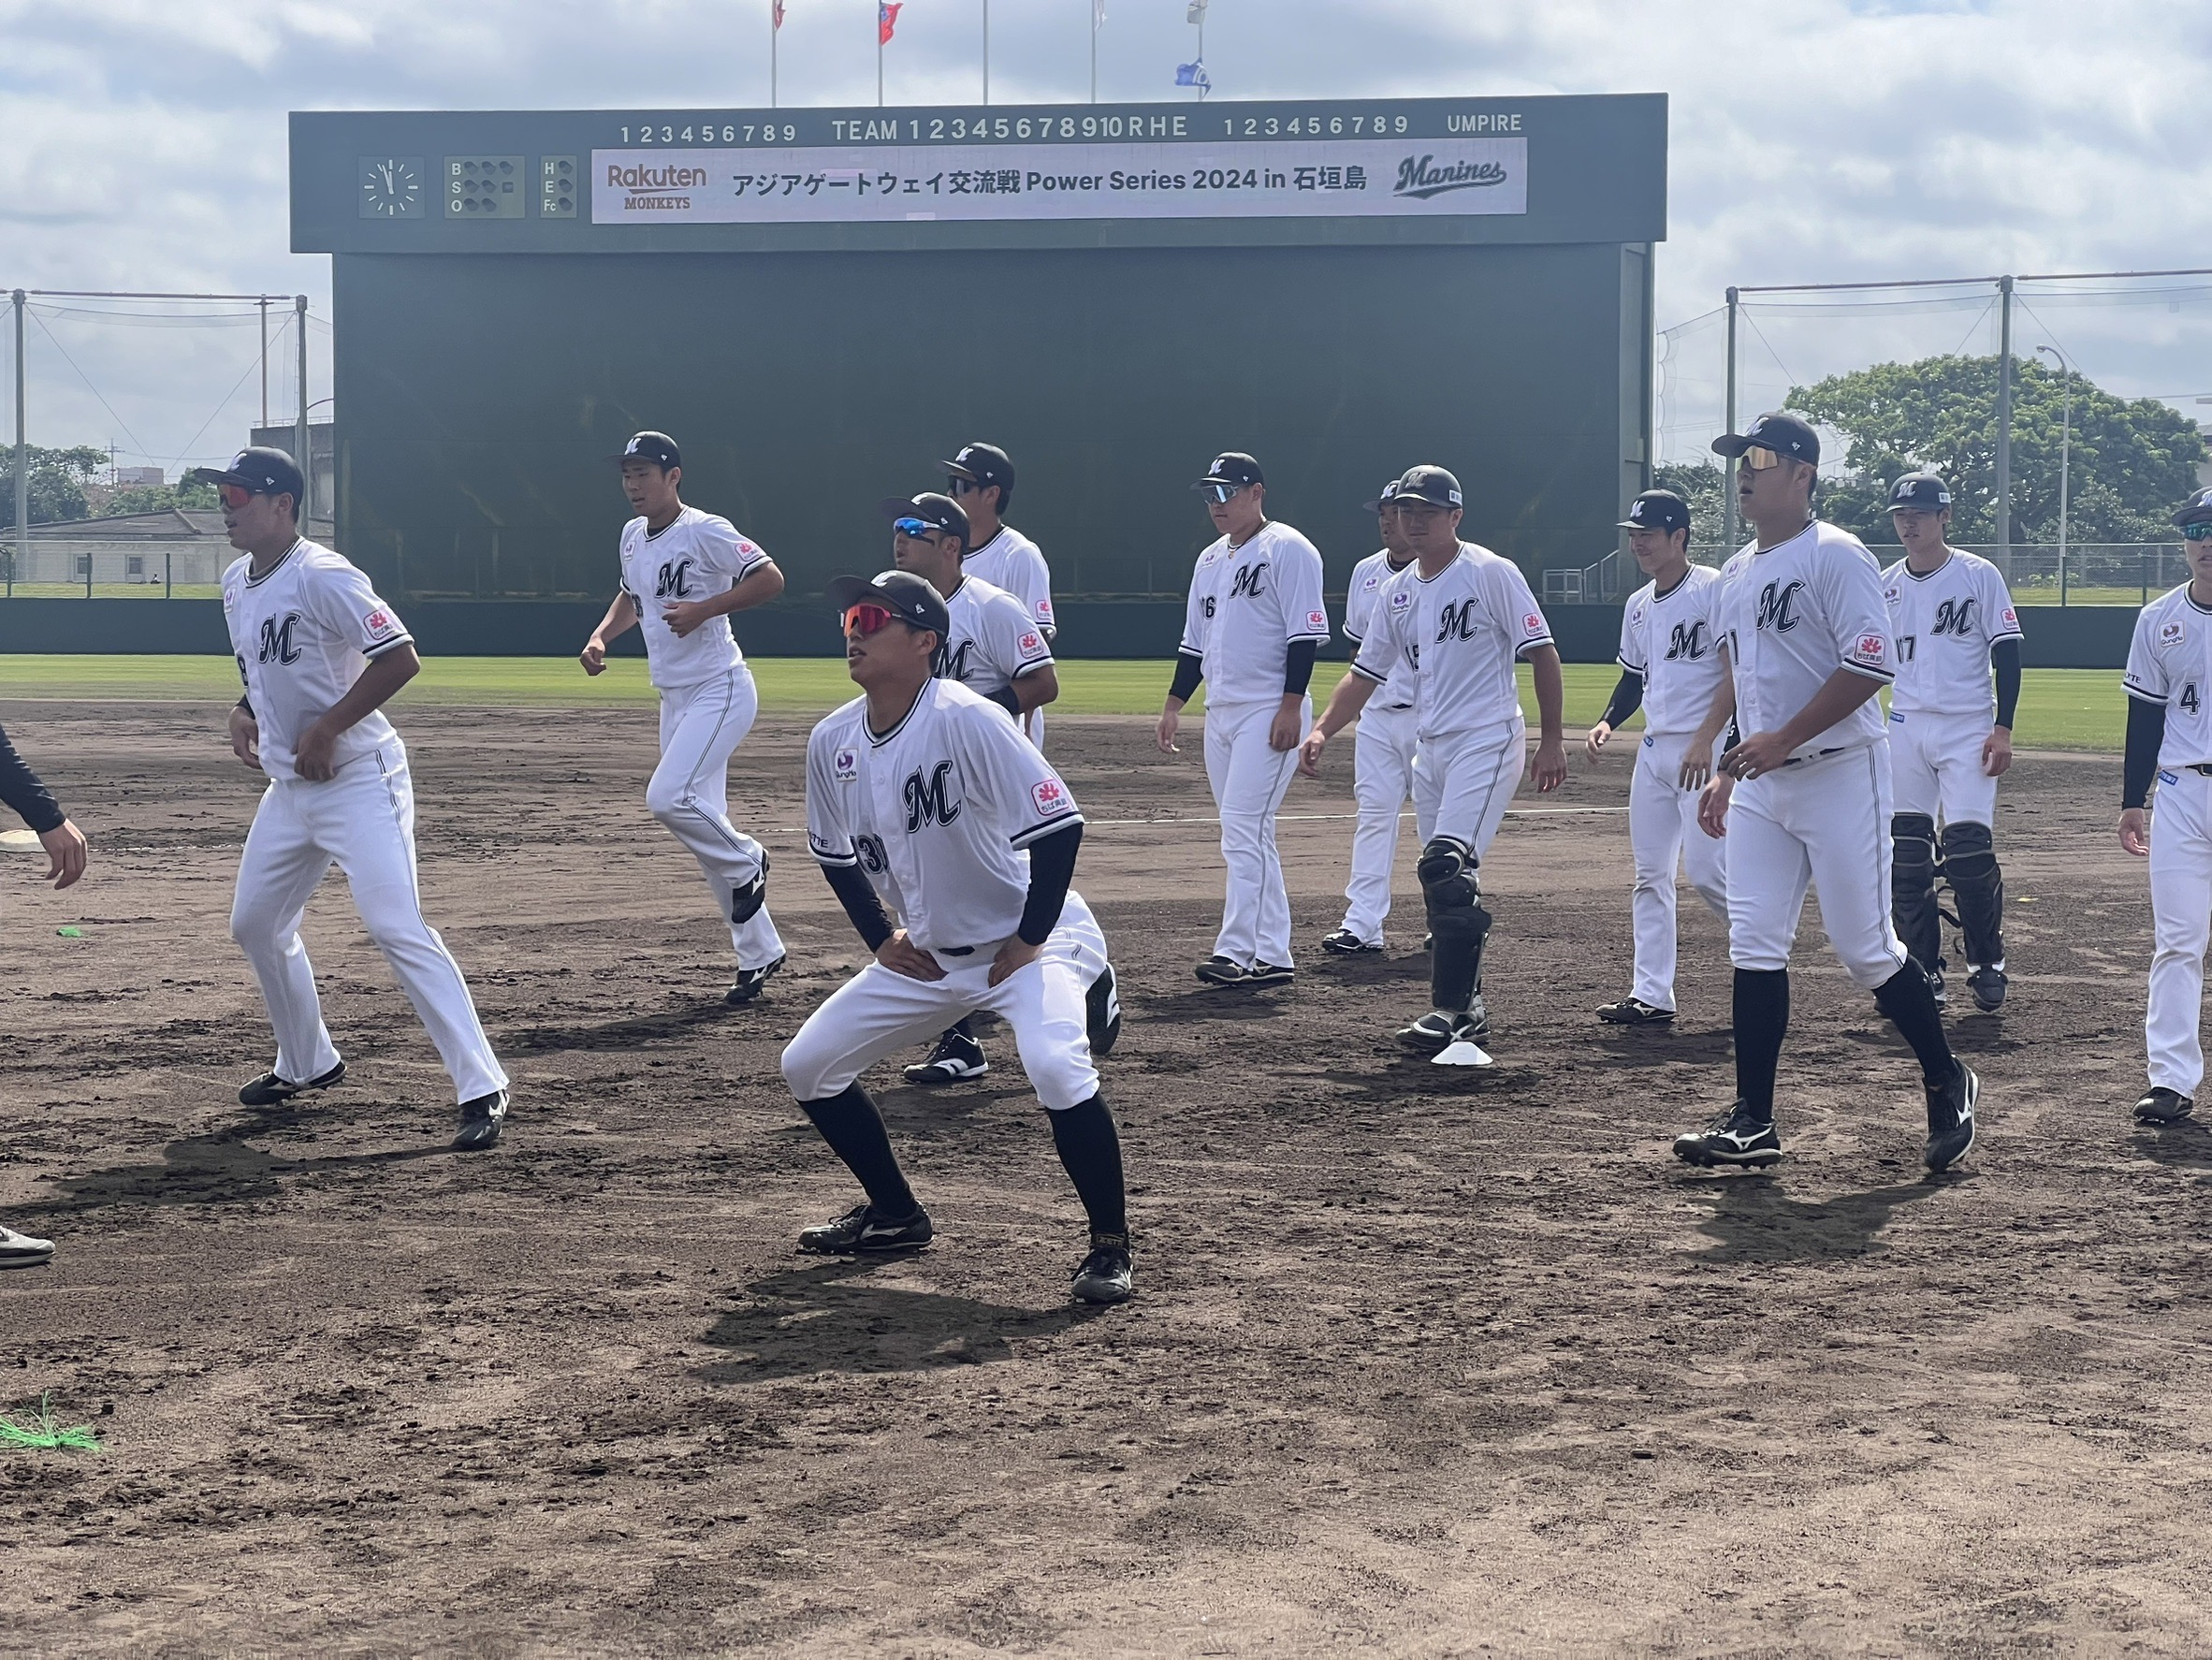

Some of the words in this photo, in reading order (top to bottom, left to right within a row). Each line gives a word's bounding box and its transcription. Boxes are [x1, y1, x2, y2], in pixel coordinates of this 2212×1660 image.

[620, 126, 629, 143] 1
[640, 125, 652, 142] 2
[662, 125, 673, 142] 3
[680, 125, 693, 142] 4
[702, 125, 714, 142] 5
[722, 125, 735, 142] 6
[743, 125, 755, 142] 7
[763, 124, 776, 141] 8
[783, 124, 795, 141] 9
[832, 119, 896, 141] TEAM
[910, 120, 918, 139] 1
[929, 119, 944, 138] 2
[951, 118, 966, 138] 3
[972, 118, 988, 138] 4
[995, 118, 1010, 138] 5
[1016, 118, 1031, 138] 6
[1038, 118, 1053, 138] 7
[1059, 117, 1075, 138] 8
[1082, 117, 1097, 138] 9
[1099, 116, 1123, 138] 10
[1129, 116, 1142, 137] R
[1150, 116, 1166, 137] H
[1173, 116, 1187, 136] E
[1224, 119, 1231, 135] 1
[1244, 118, 1257, 135] 2
[1264, 118, 1279, 135] 3
[1287, 117, 1301, 135] 4
[1308, 117, 1320, 134] 5
[1330, 117, 1343, 134] 6
[1352, 116, 1364, 134] 7
[1374, 116, 1387, 133] 8
[1395, 116, 1407, 133] 9
[1448, 114, 1522, 132] UMPIRE
[451, 163, 461, 176] B
[545, 162, 554, 175] H
[607, 164, 706, 187] Rakuten
[1392, 153, 1507, 199] Marines
[451, 181, 461, 194] S
[545, 181, 554, 194] E
[733, 168, 1022, 197] アジアゲートウェイ交流戦
[1026, 171, 1104, 192] Power
[1109, 168, 1186, 191] Series
[1192, 168, 1259, 190] 2024
[1264, 167, 1286, 189] in
[1292, 165, 1368, 192] 石垣島
[451, 199, 462, 212] O
[544, 199, 557, 211] Fc
[624, 197, 691, 211] MONKEYS
[1896, 481, 1917, 499] M
[655, 557, 694, 600] M
[1230, 561, 1271, 600] M
[1756, 577, 1806, 633] M
[1931, 595, 1978, 637] M
[1434, 596, 1479, 645] M
[257, 612, 302, 666] M
[1663, 619, 1708, 661] M
[2161, 636, 2183, 646] GungHo
[2178, 681, 2201, 716] 4
[902, 760, 962, 834] M
